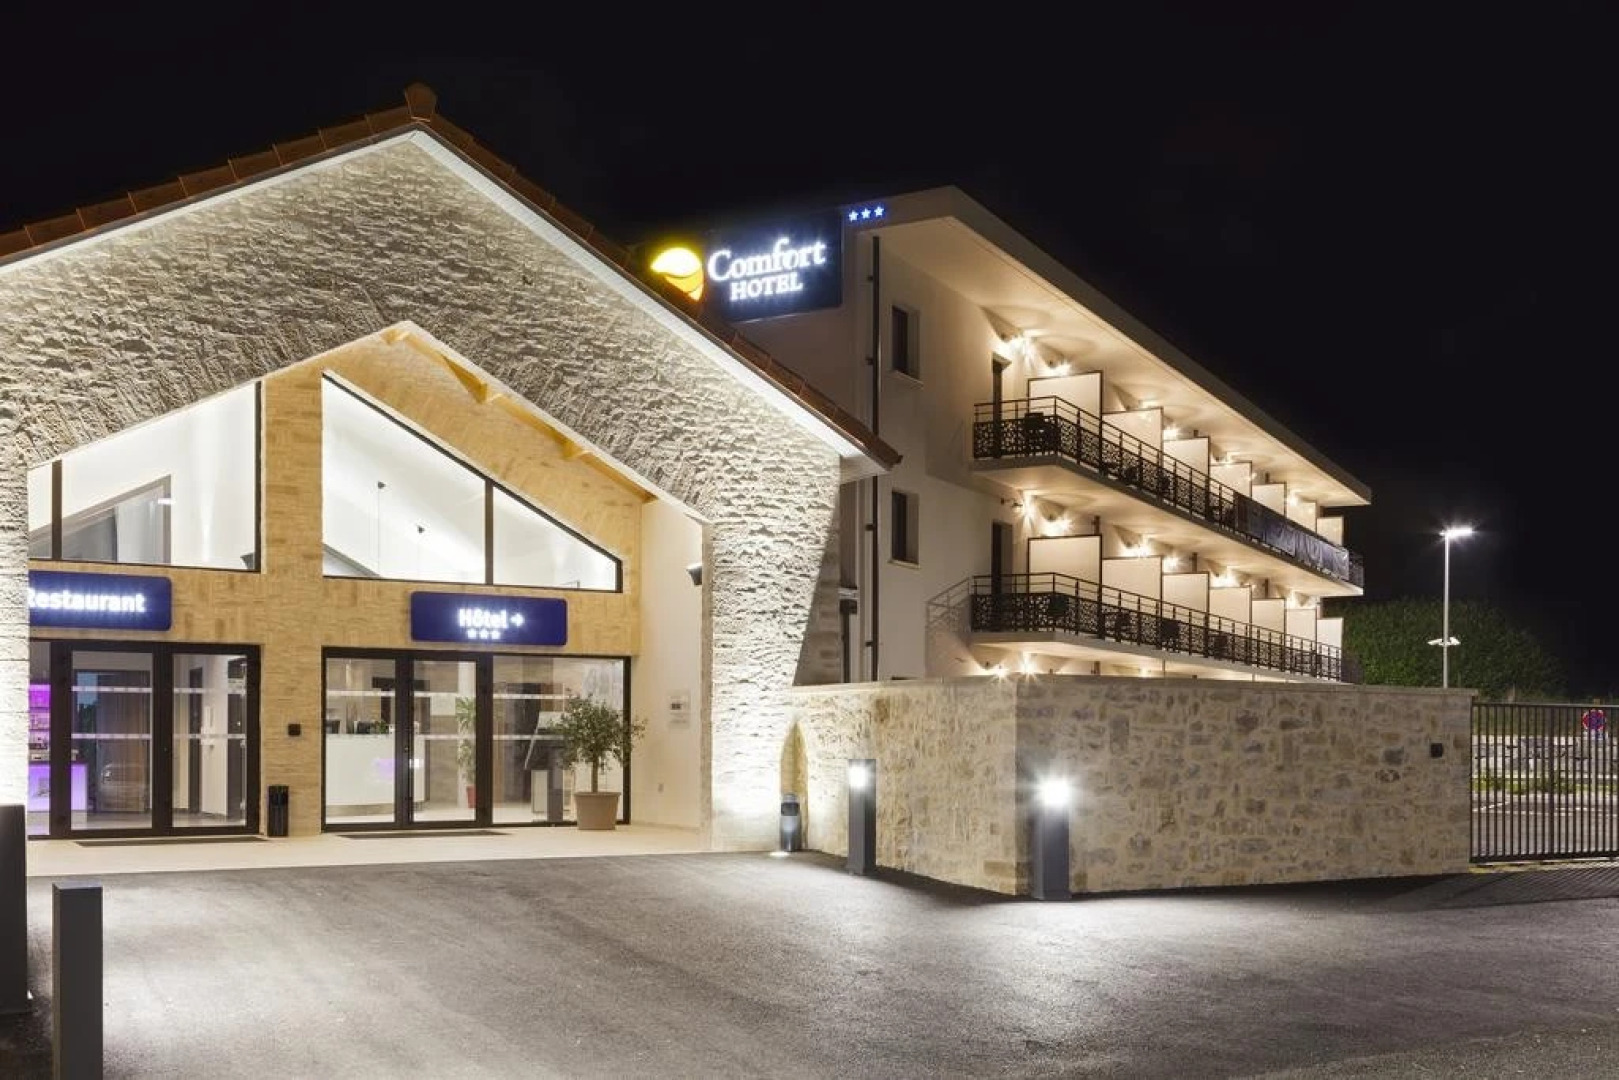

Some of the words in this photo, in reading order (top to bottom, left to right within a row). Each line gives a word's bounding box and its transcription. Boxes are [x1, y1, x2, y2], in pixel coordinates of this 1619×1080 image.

[707, 236, 825, 281] Comfort
[730, 272, 803, 301] HOTEL
[459, 608, 508, 629] Hôtel
